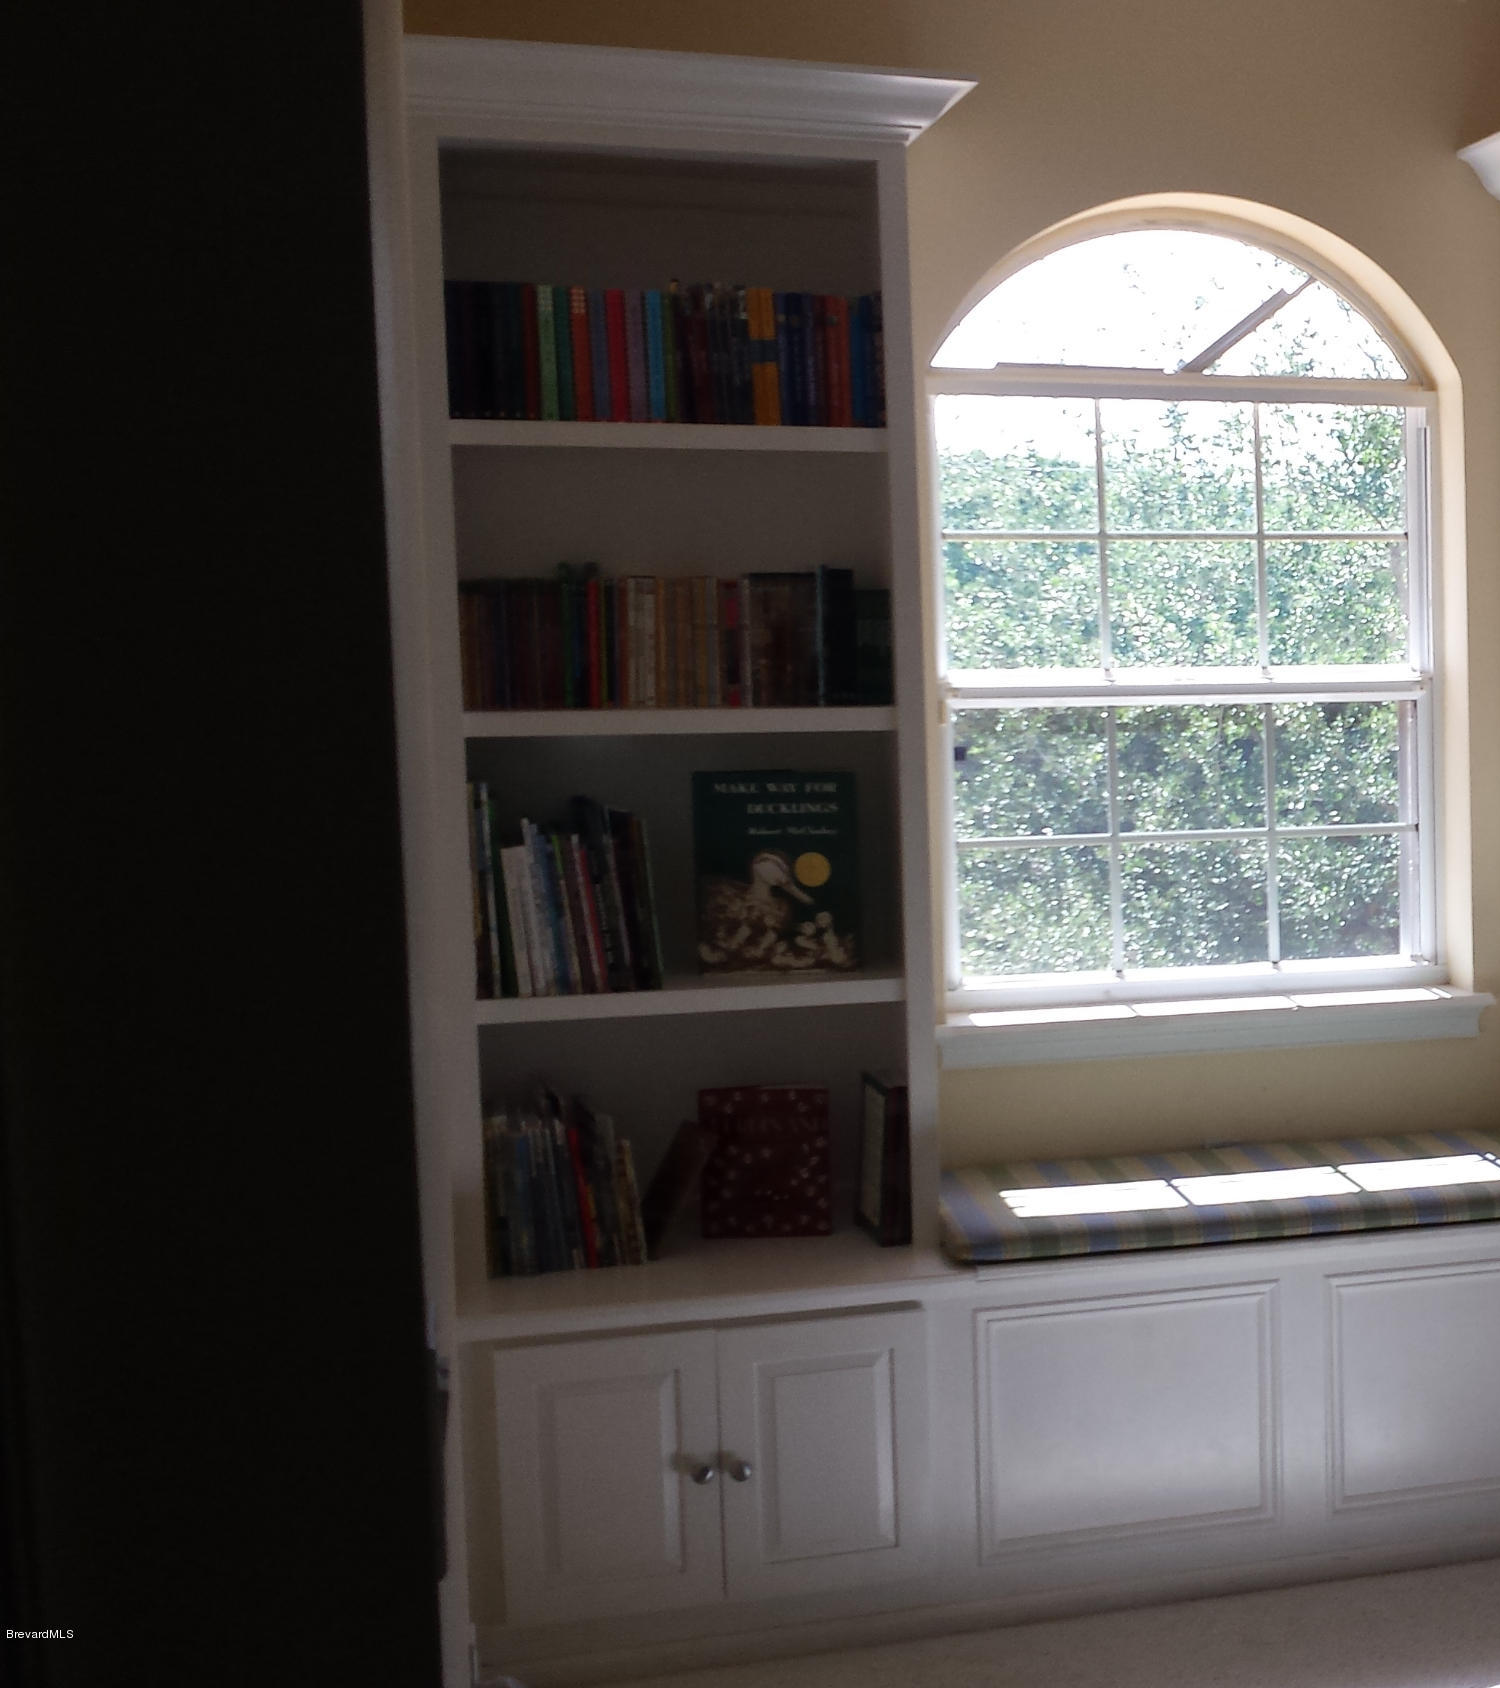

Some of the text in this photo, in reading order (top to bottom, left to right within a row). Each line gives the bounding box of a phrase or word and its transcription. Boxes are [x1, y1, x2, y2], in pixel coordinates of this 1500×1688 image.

[713, 781, 838, 794] MAKE WAY FOR
[745, 802, 840, 814] DUCKLINGS
